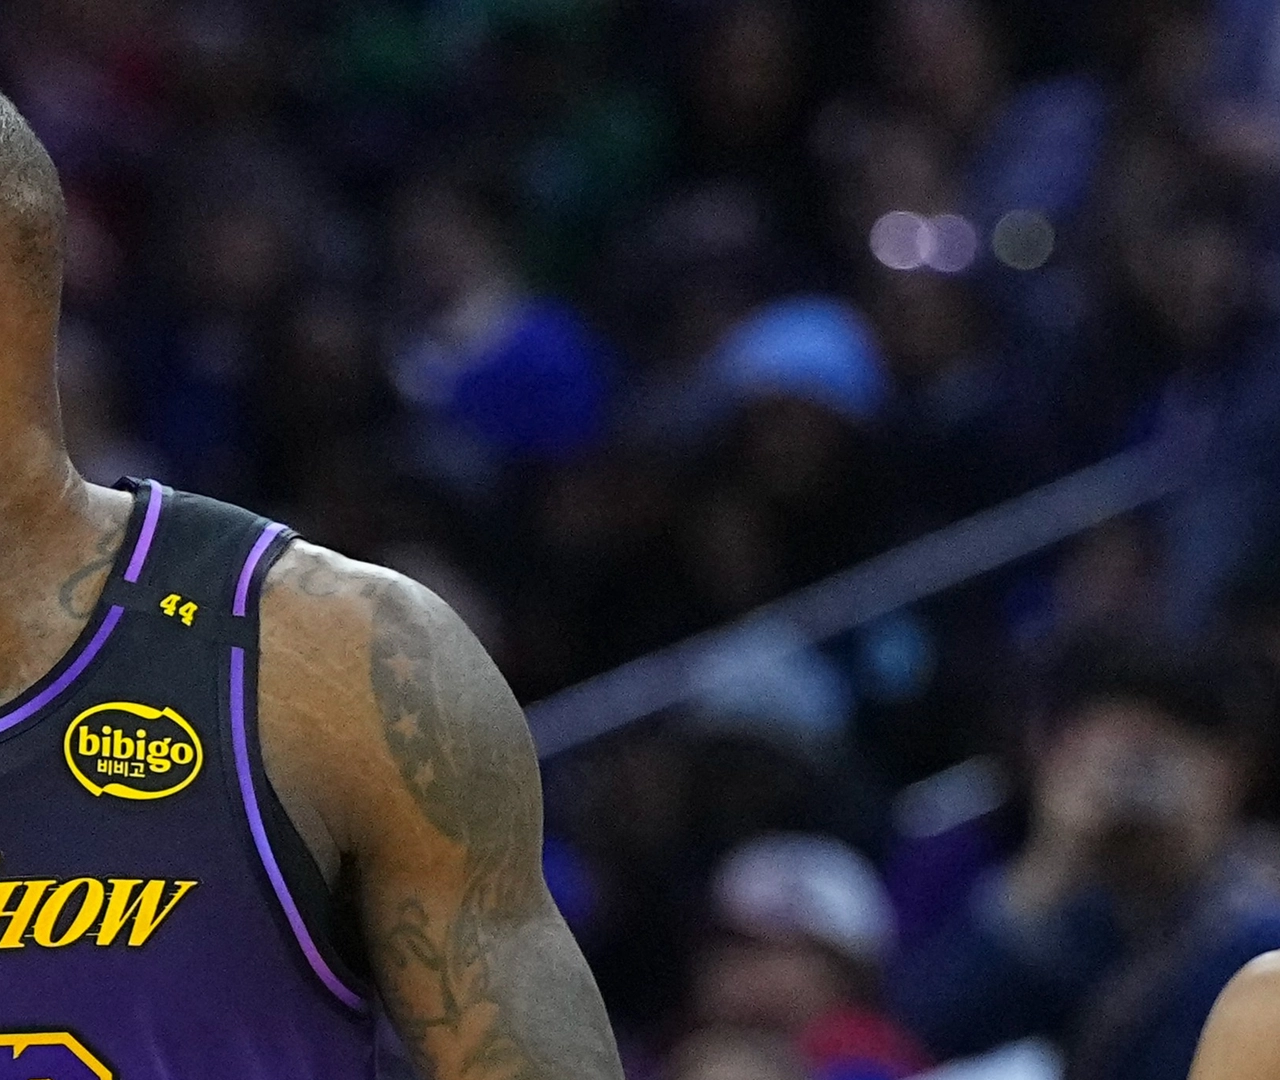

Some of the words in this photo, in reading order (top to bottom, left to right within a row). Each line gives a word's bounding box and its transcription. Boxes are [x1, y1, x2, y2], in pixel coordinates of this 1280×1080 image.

[160, 593, 199, 627] 44
[78, 725, 194, 773] bibigo
[96, 758, 146, 778] 비비고
